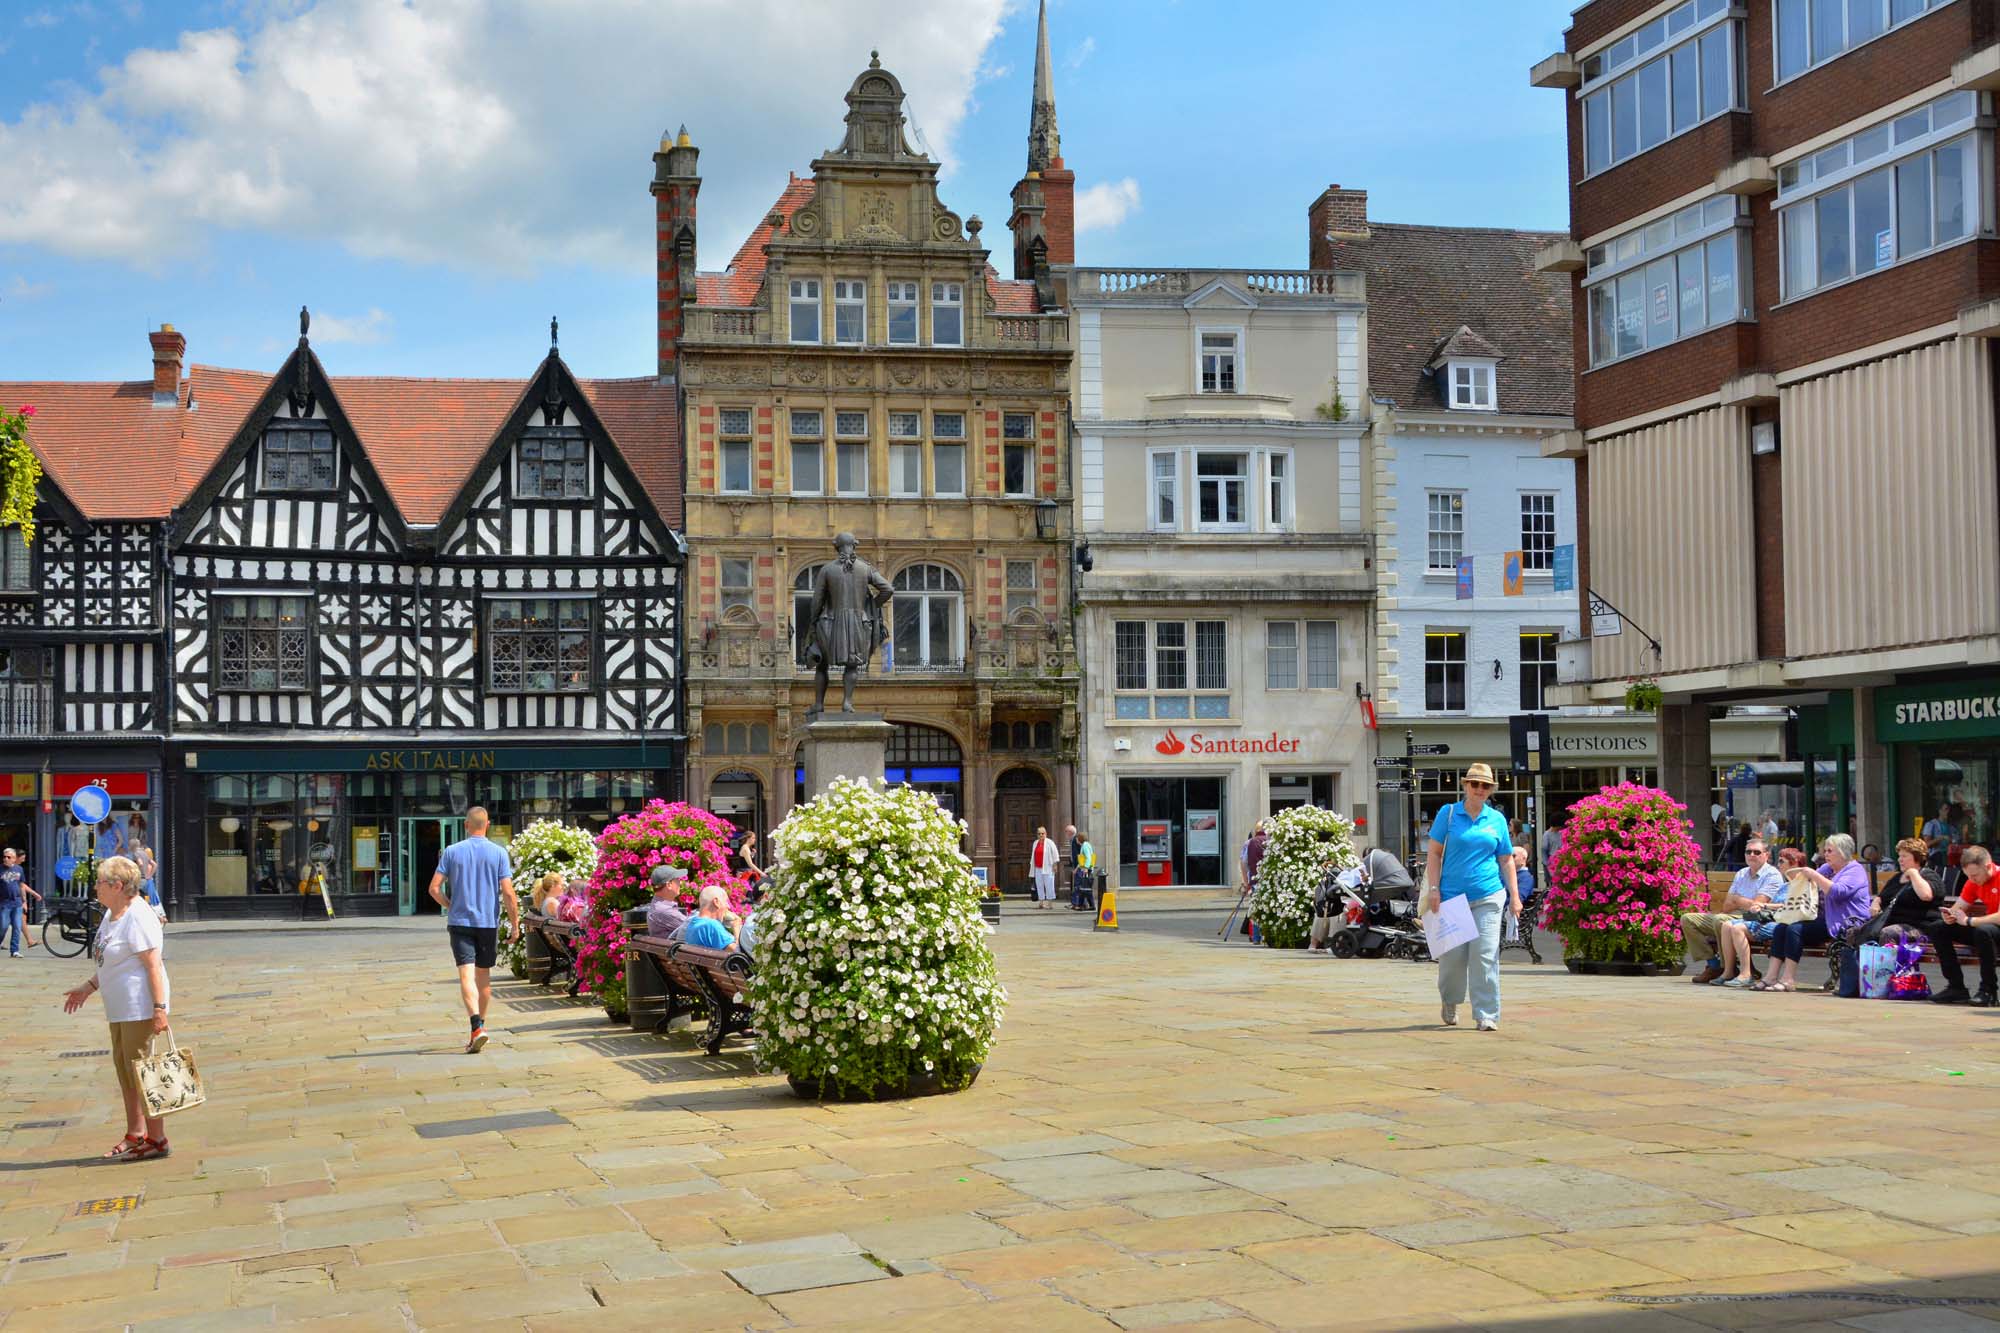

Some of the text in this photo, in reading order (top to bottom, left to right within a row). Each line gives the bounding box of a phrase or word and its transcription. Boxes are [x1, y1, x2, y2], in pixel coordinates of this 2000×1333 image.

[1190, 732, 1300, 754] Santander
[1550, 735, 1648, 751] terstones
[366, 751, 496, 769] ASK ITALIAN
